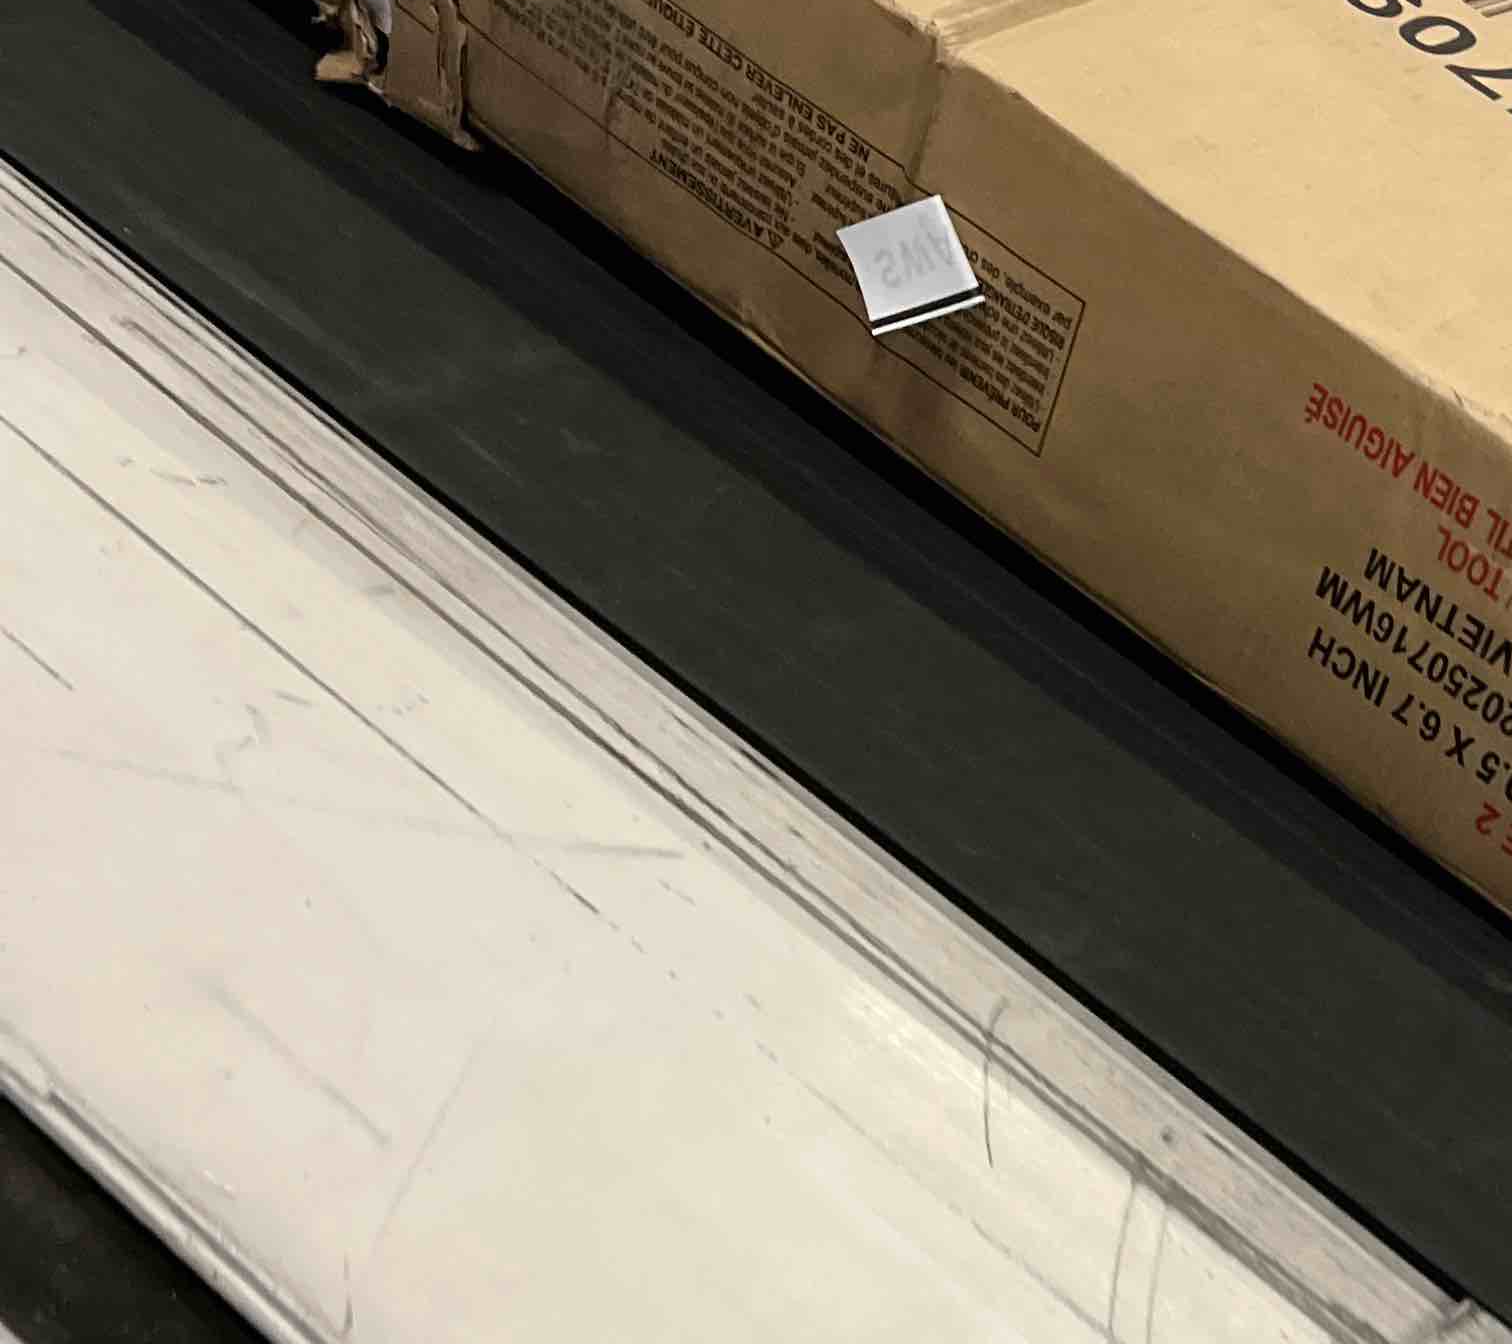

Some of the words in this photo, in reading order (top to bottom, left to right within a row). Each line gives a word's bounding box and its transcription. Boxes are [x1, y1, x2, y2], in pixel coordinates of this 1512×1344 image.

[696, 26, 743, 73] CETTE
[743, 60, 815, 124] ENLEVER
[815, 113, 847, 147] PAS
[847, 135, 870, 164] NE
[1302, 378, 1415, 473] AIGUISÉ
[1410, 456, 1480, 531] BIEN
[1433, 523, 1505, 602] TOOL
[1362, 543, 1510, 676] VIETNAM
[1307, 624, 1390, 709] INCH
[1390, 690, 1442, 746] 6.7
[1443, 723, 1475, 769] X
[1473, 799, 1501, 840] 2
